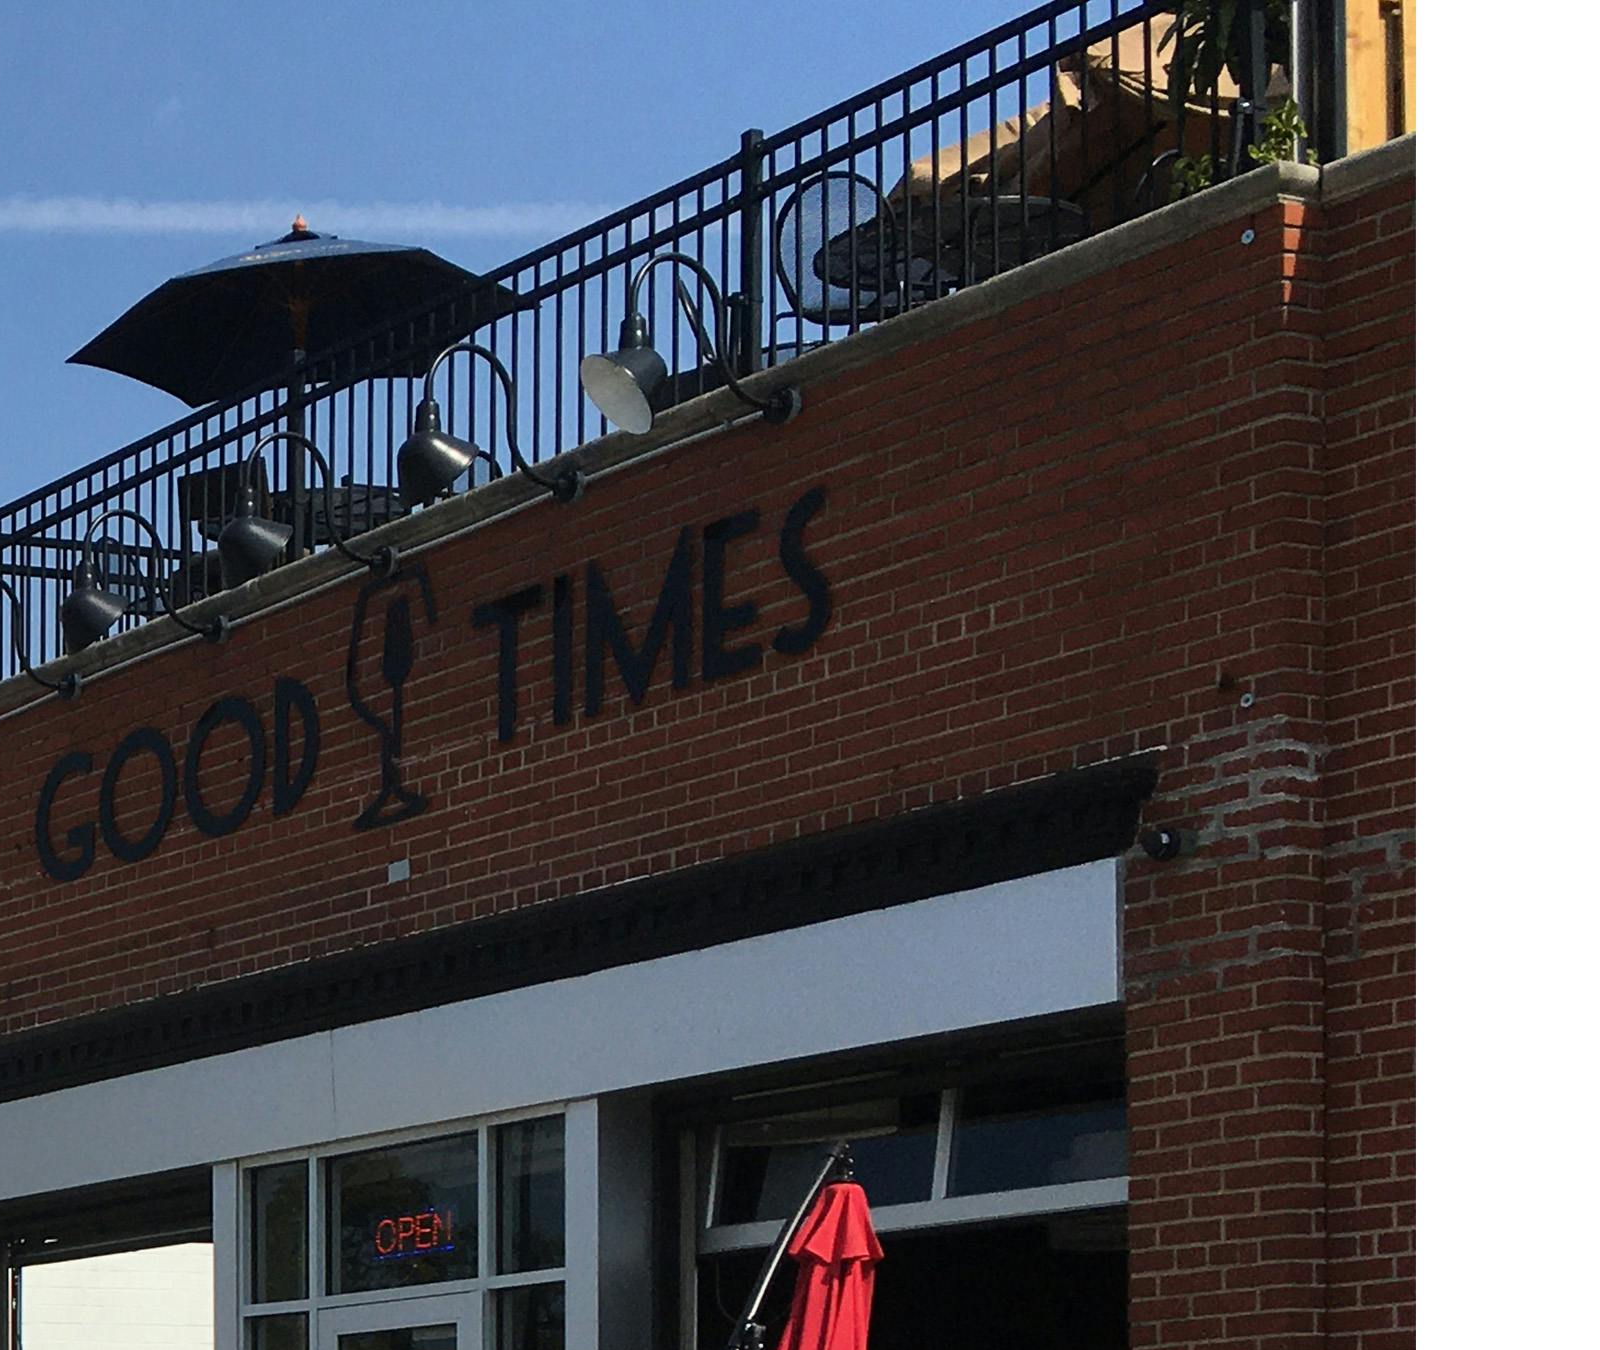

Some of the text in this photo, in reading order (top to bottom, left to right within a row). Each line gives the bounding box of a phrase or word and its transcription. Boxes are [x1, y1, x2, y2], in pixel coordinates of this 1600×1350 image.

[34, 486, 834, 883] GOOD TIMES
[375, 1211, 451, 1253] OPEN
